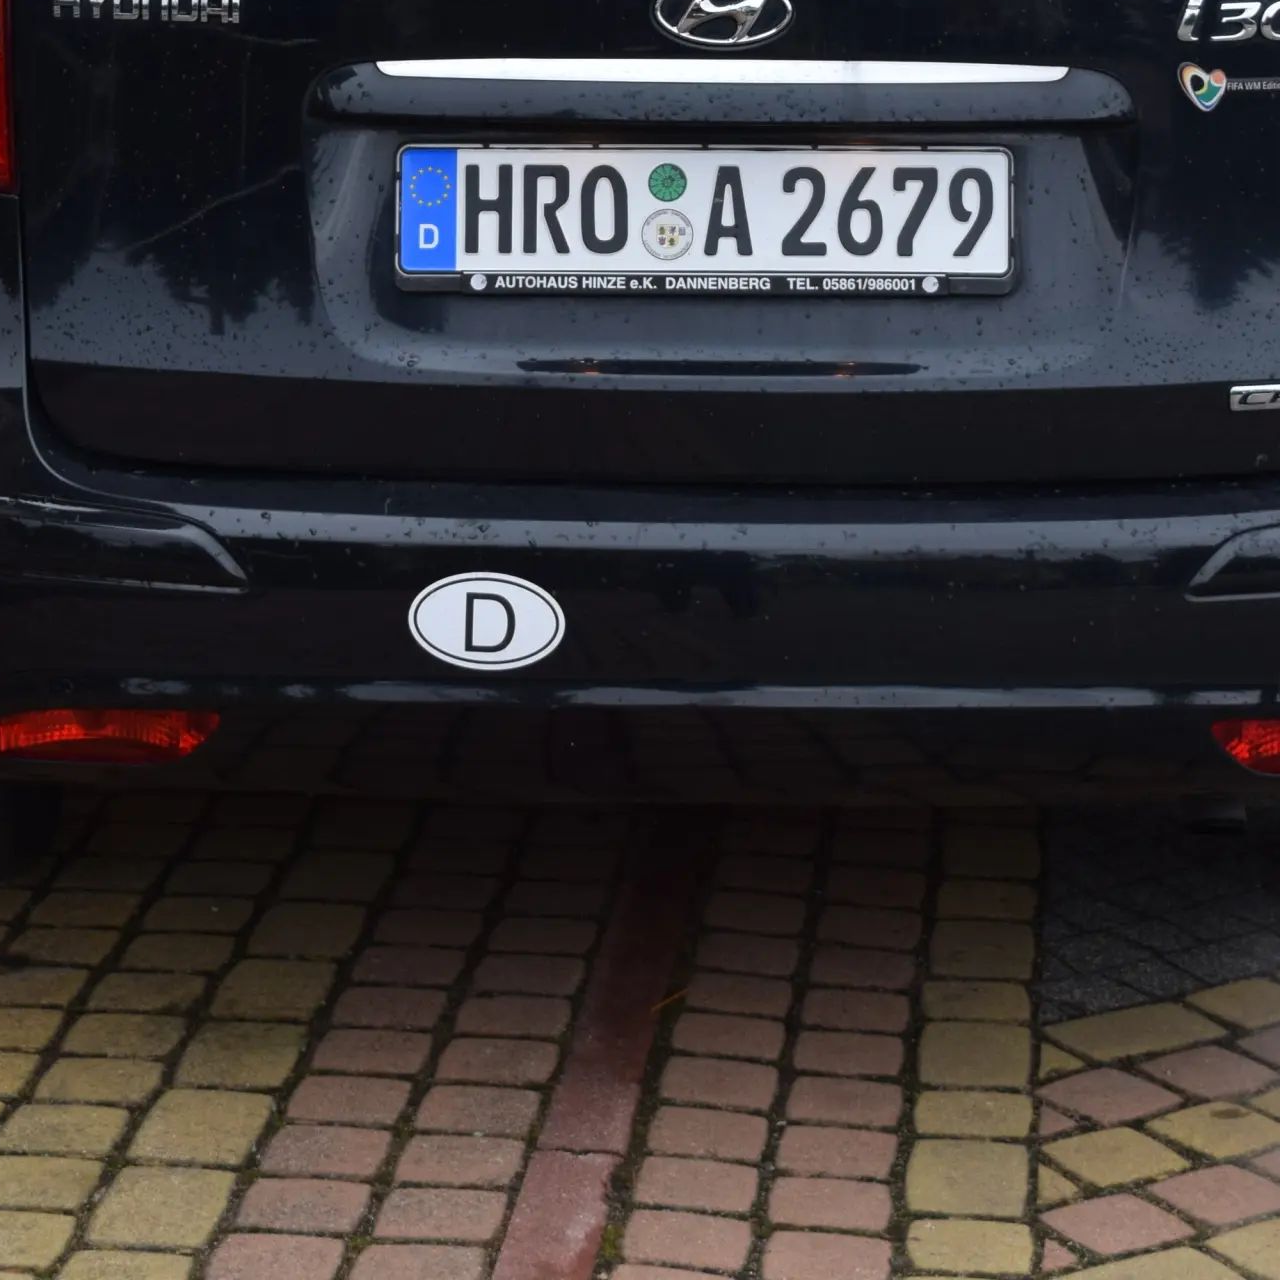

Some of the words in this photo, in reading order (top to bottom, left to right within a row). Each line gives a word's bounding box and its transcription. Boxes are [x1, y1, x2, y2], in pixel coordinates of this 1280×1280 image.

[1227, 82, 1244, 91] FIFA
[1245, 81, 1261, 90] WM
[463, 163, 630, 255] HRO
[703, 165, 753, 257] A
[782, 166, 995, 258] 2679
[418, 223, 439, 250] D
[495, 276, 578, 289] AUTOHAUS
[582, 276, 626, 290] HINZE
[629, 277, 658, 290] e.K.
[665, 277, 771, 291] DANNENBERG
[786, 277, 819, 291] TEL.
[822, 278, 916, 291] 05861/986001
[464, 591, 517, 653] D
